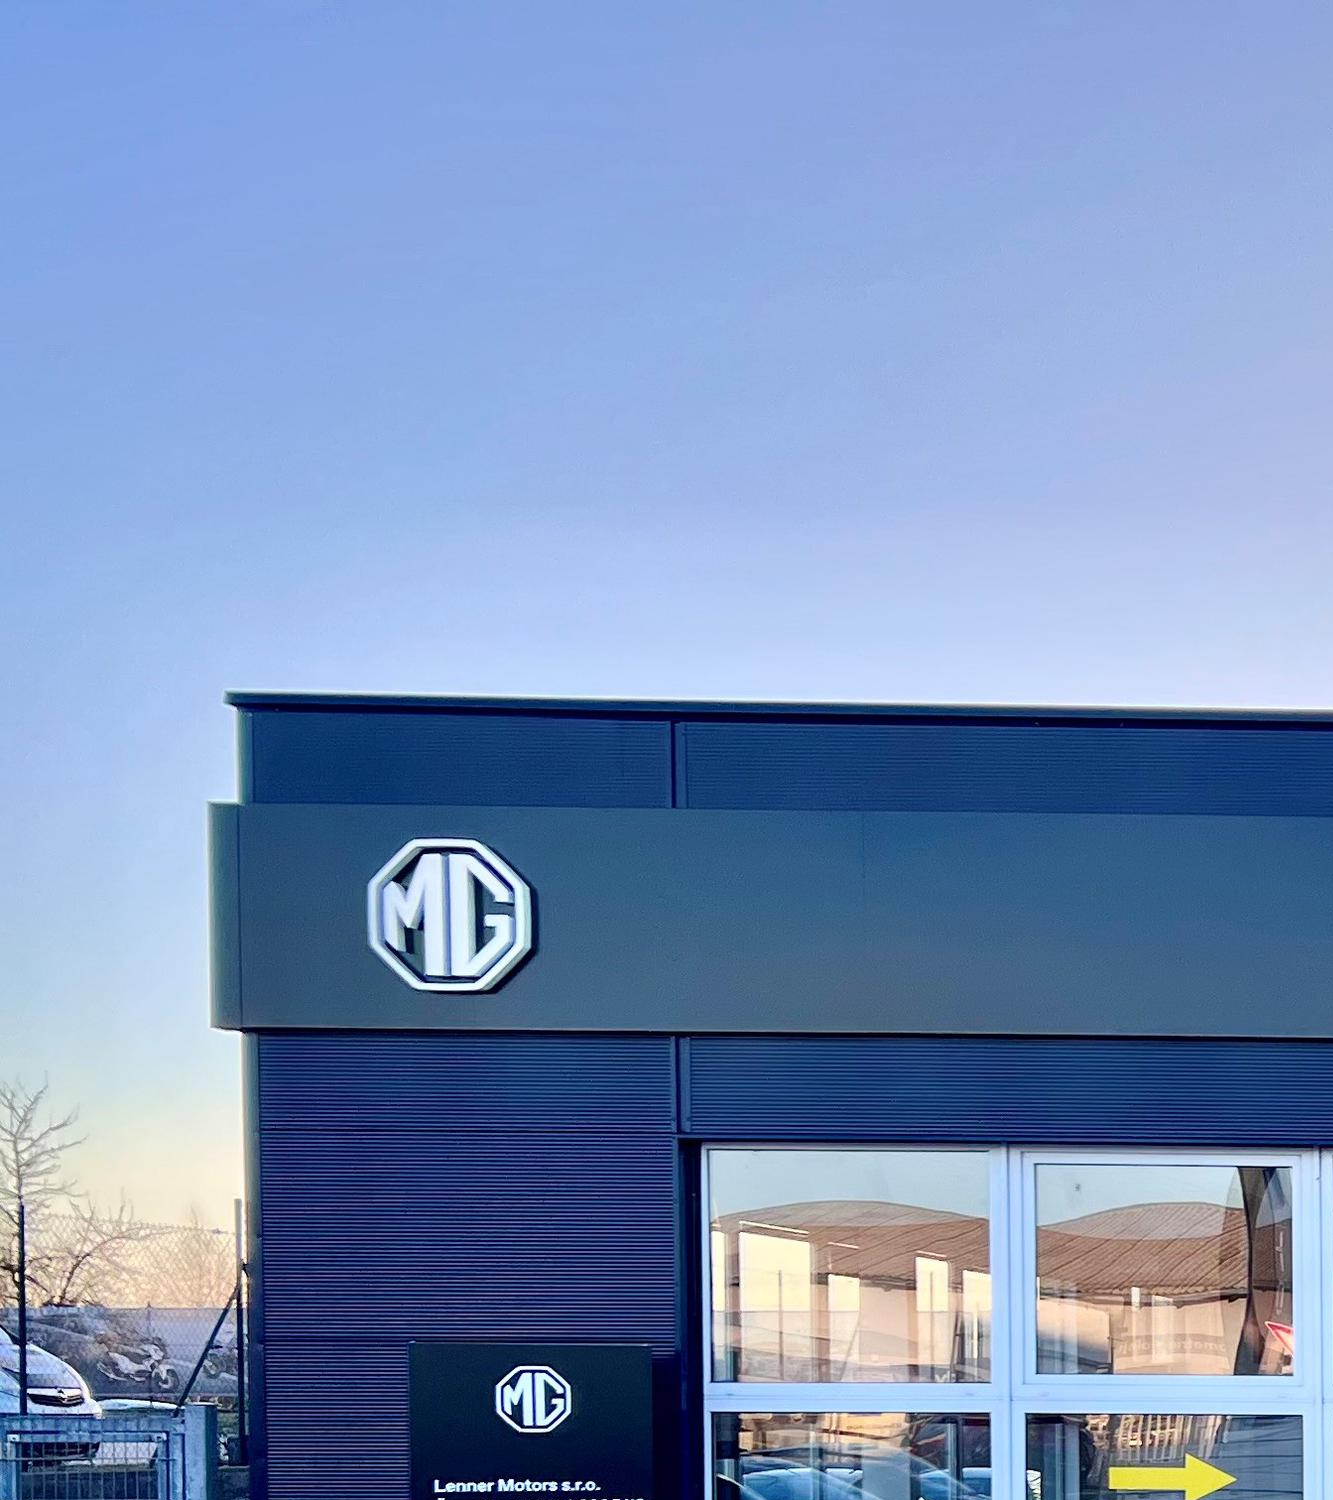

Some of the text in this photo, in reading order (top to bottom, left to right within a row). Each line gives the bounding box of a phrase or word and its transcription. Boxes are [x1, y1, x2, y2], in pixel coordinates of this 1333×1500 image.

[380, 849, 518, 980] MG
[501, 1371, 566, 1428] MG
[433, 1478, 602, 1493] Lenner Motors s.r.o.
